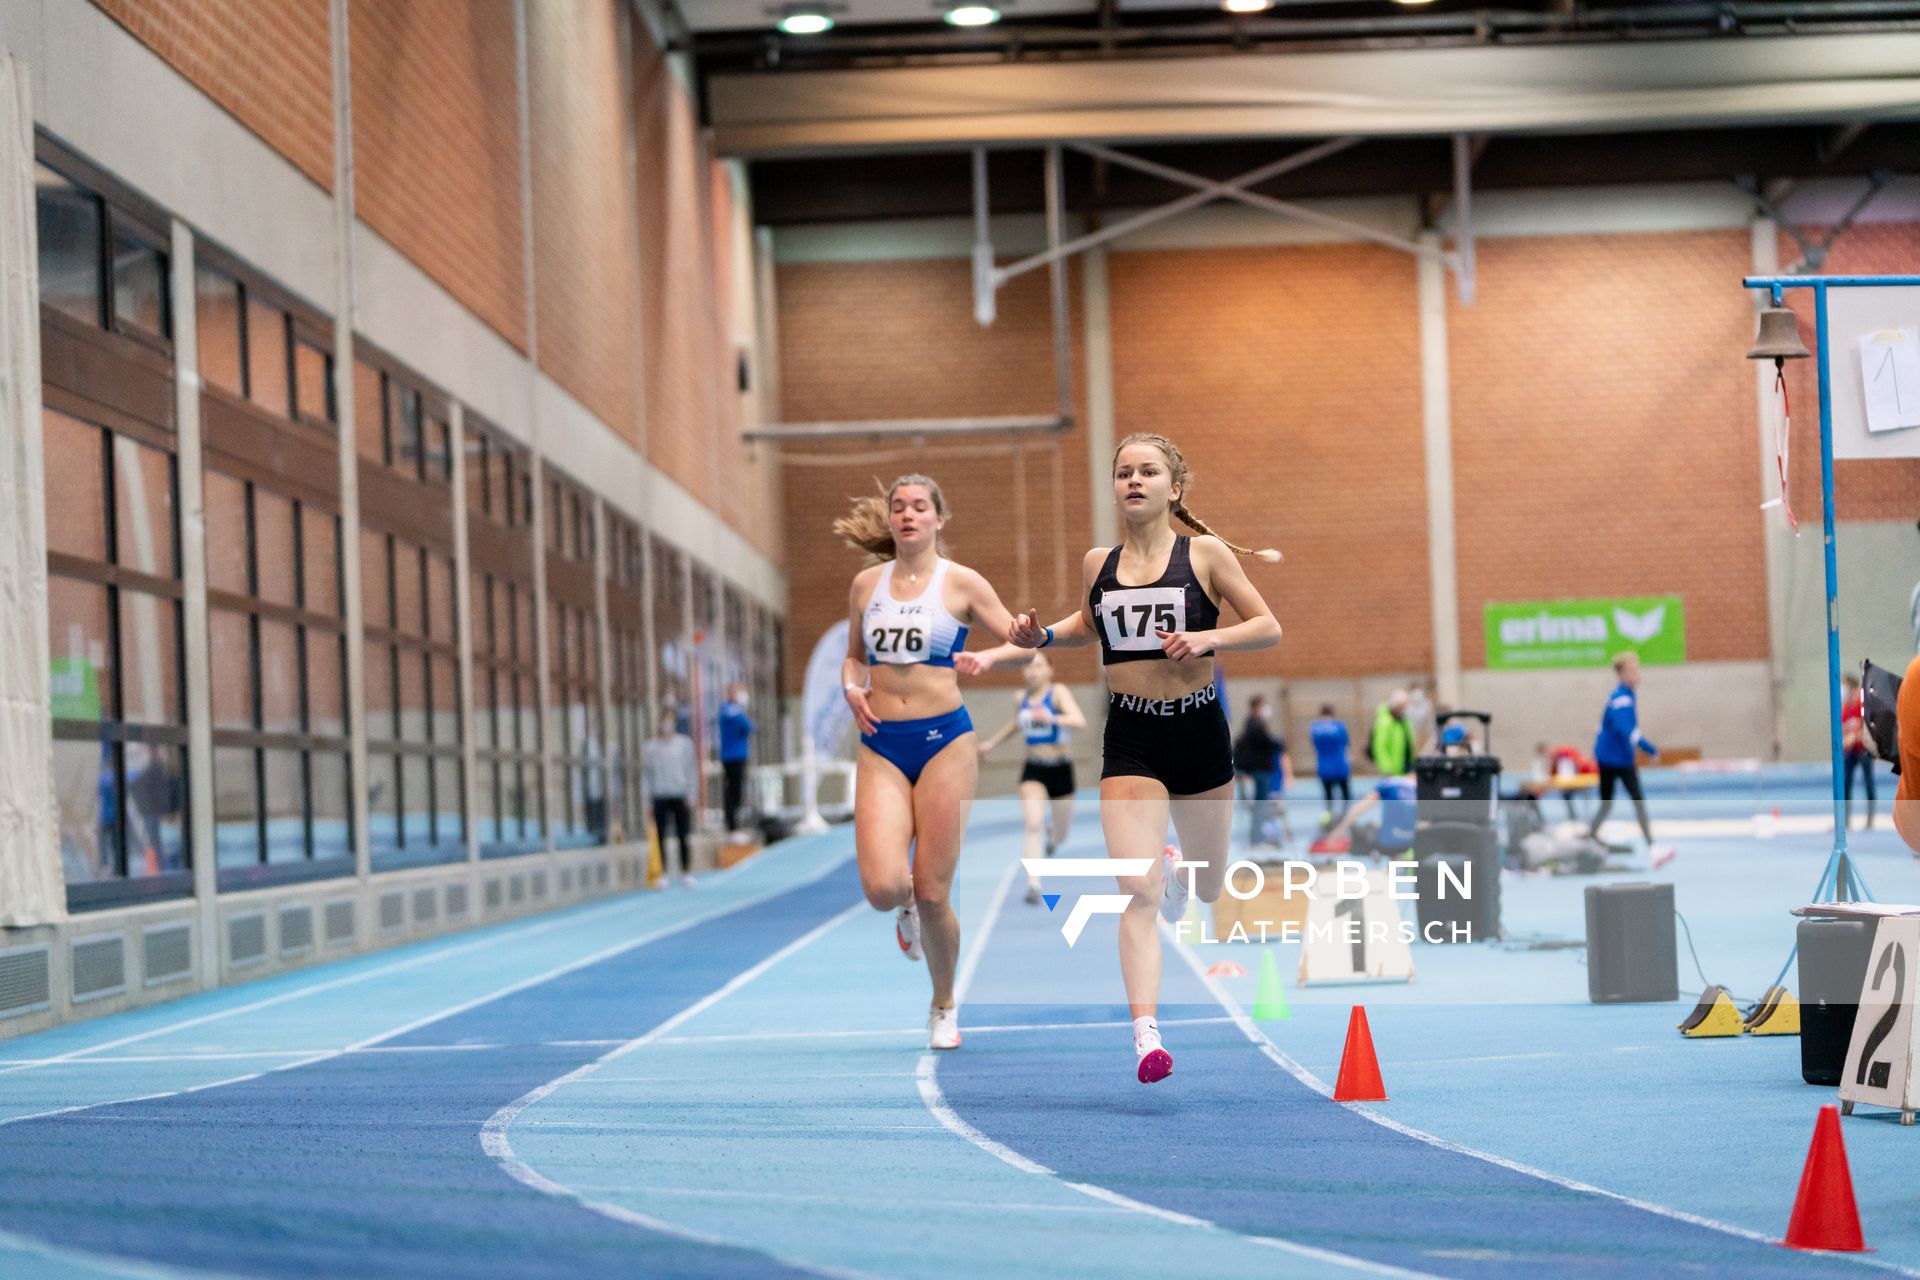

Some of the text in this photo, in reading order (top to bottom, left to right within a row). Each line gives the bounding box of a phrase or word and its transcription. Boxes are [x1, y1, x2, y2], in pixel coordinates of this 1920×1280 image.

[1874, 345, 1902, 416] 1
[1110, 602, 1178, 638] 175
[1501, 611, 1608, 645] erima
[872, 626, 923, 653] 276
[1119, 682, 1216, 716] NIKE PRO
[1334, 896, 1367, 973] 1
[1855, 940, 1906, 1090] 2
